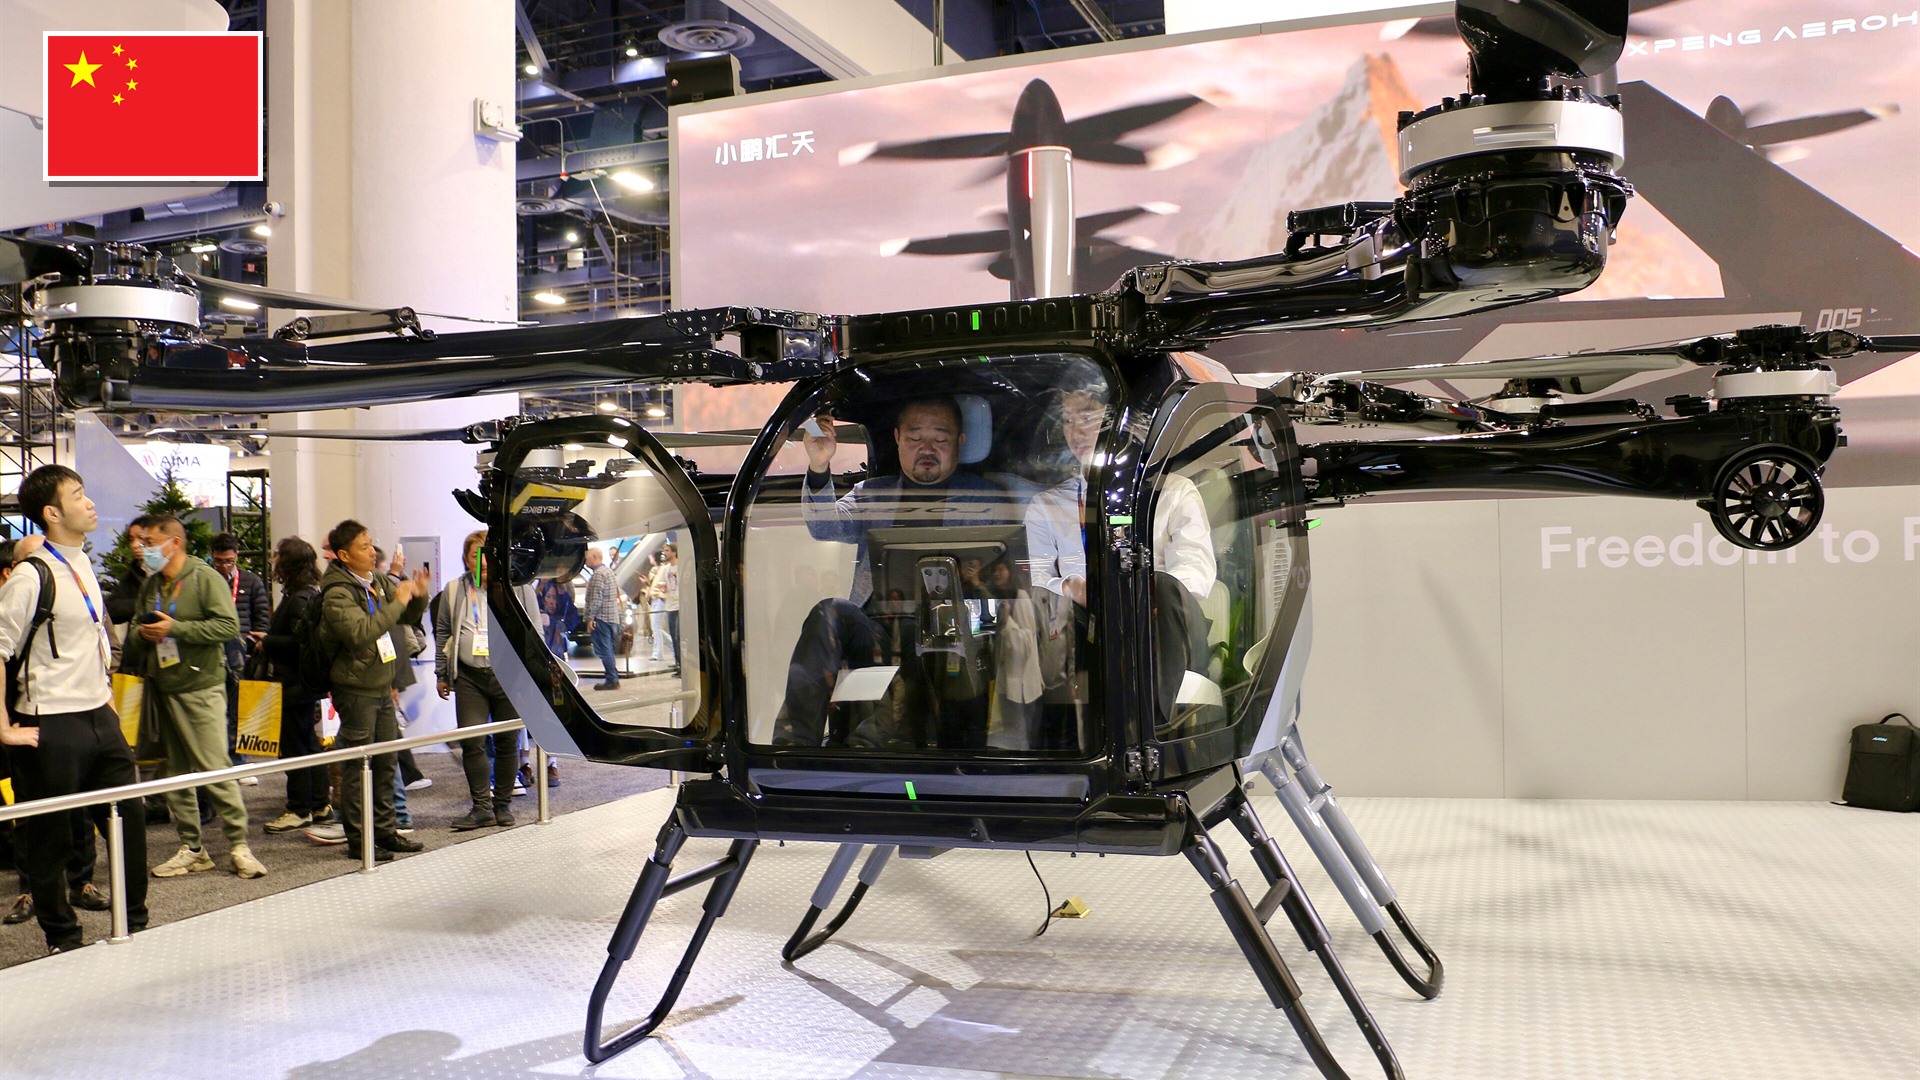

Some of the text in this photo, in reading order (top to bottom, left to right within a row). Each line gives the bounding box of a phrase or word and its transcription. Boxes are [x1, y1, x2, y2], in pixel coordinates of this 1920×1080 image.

[1626, 10, 1918, 57] XPENG AEROH
[714, 130, 815, 166] 小鹏汇天
[1818, 523, 1879, 563] to
[237, 734, 279, 754] Nikon
